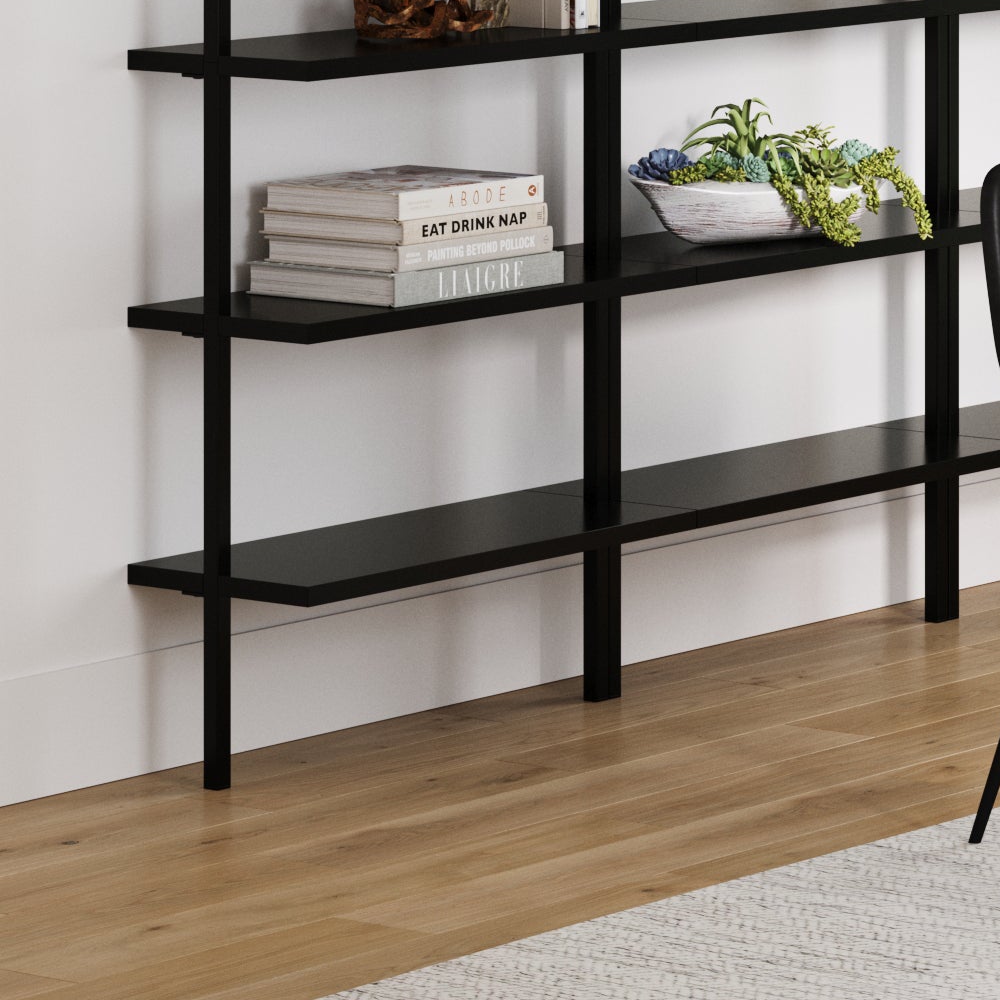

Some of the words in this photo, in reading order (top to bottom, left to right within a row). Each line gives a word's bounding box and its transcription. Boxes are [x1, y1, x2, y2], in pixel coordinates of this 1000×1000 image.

[422, 222, 447, 237] EAT
[452, 215, 495, 234] DRINK
[499, 211, 527, 227] NAP
[427, 246, 464, 262] PAINTING
[467, 241, 498, 257] BEYOND
[500, 235, 536, 252] POLLOCK
[439, 260, 524, 299] LIAIGRE
